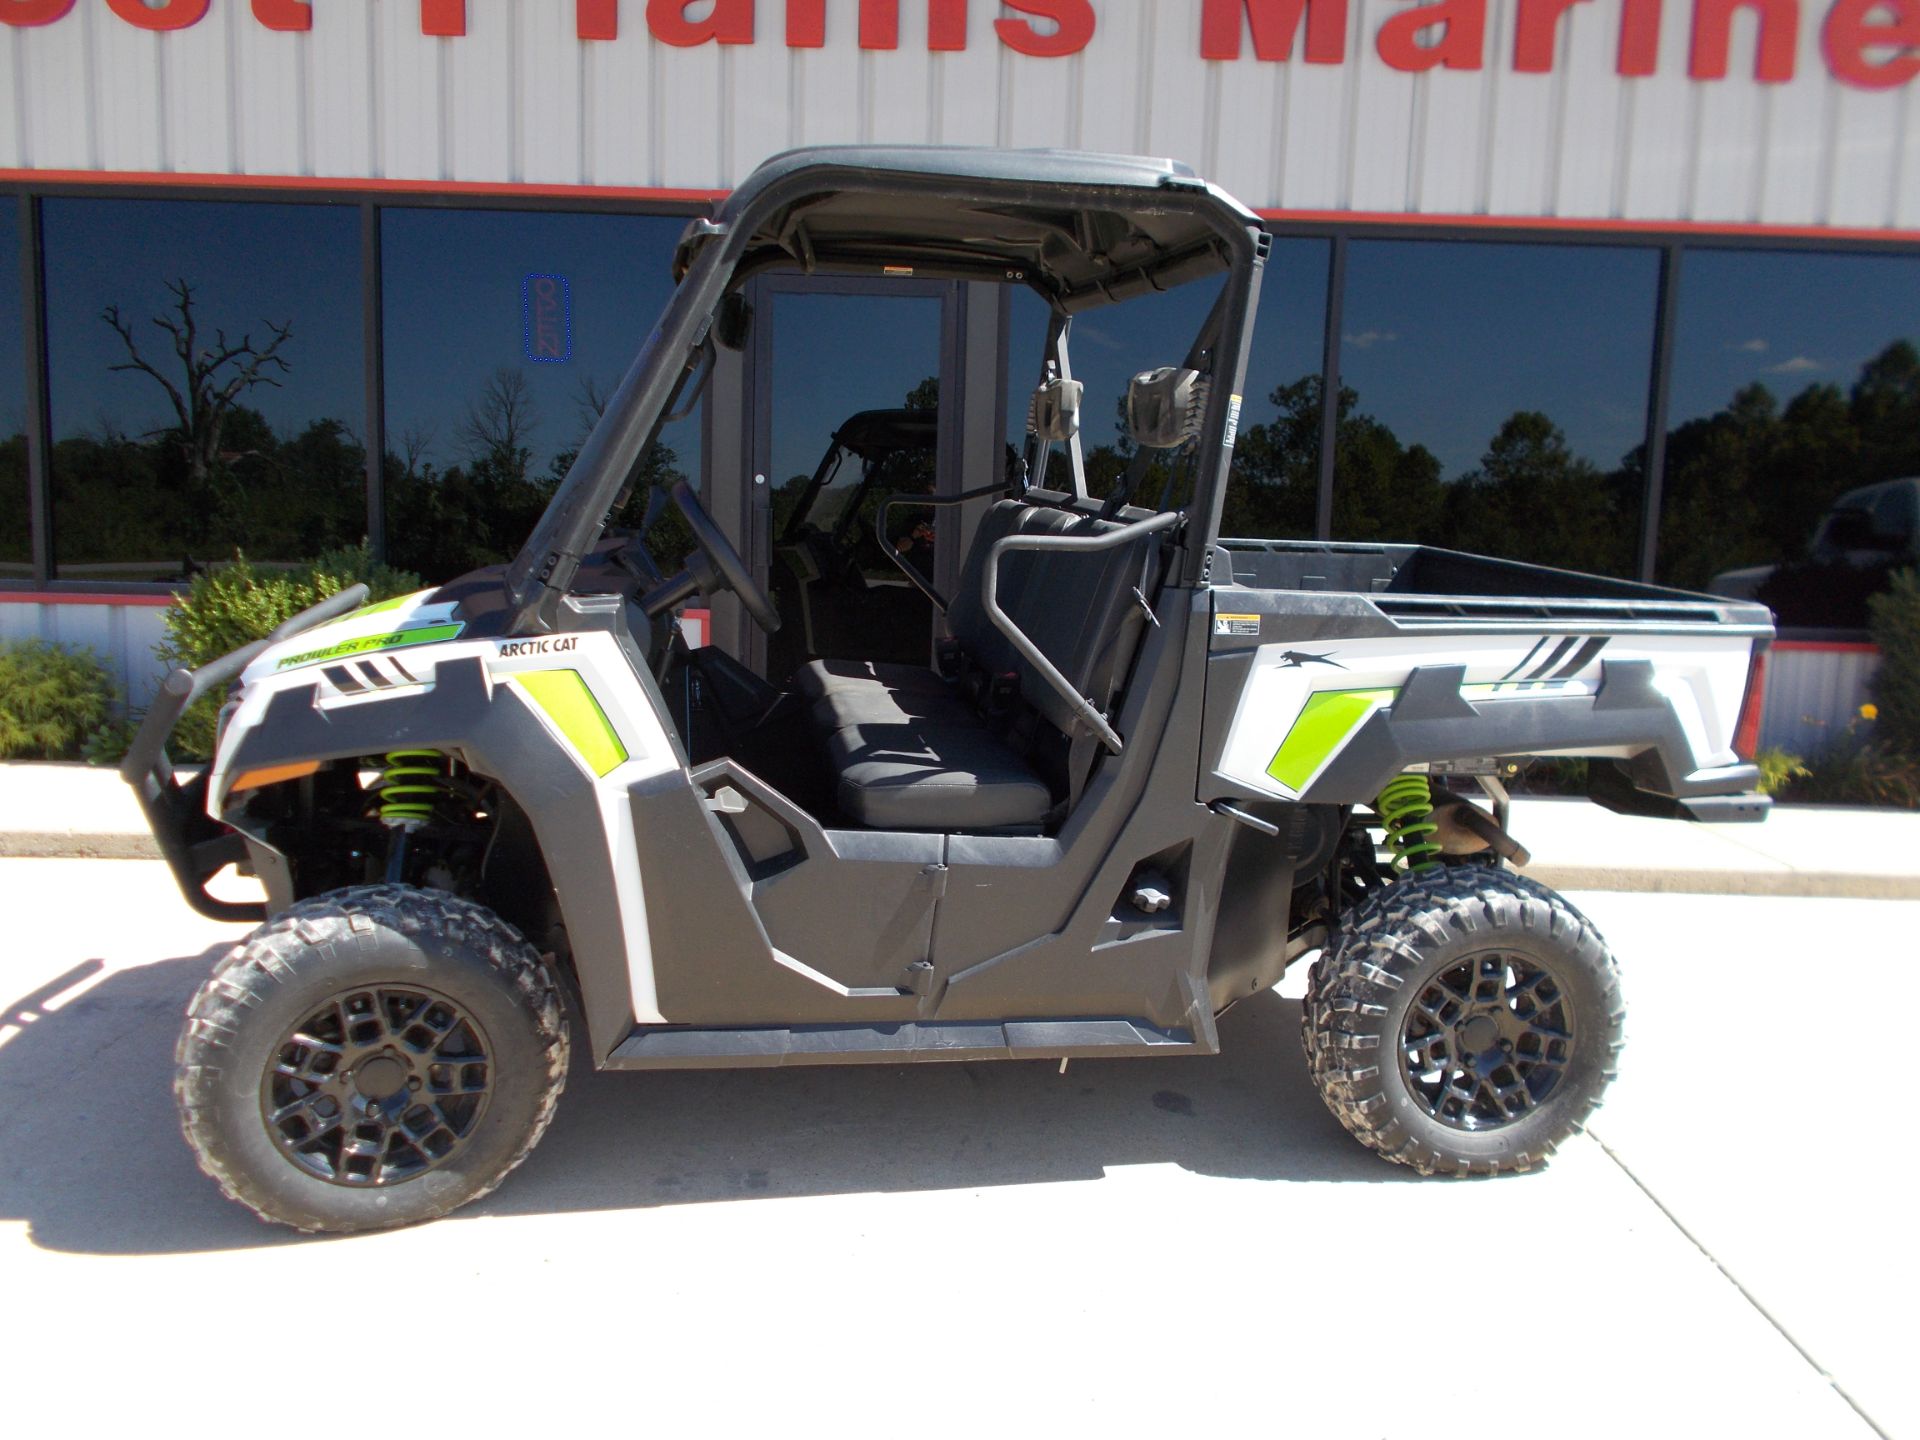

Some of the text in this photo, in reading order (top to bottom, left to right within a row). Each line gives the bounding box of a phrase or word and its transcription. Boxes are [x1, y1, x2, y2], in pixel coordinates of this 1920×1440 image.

[276, 633, 404, 670] PROWLER PRO
[499, 637, 579, 658] ARCTIC CAT
